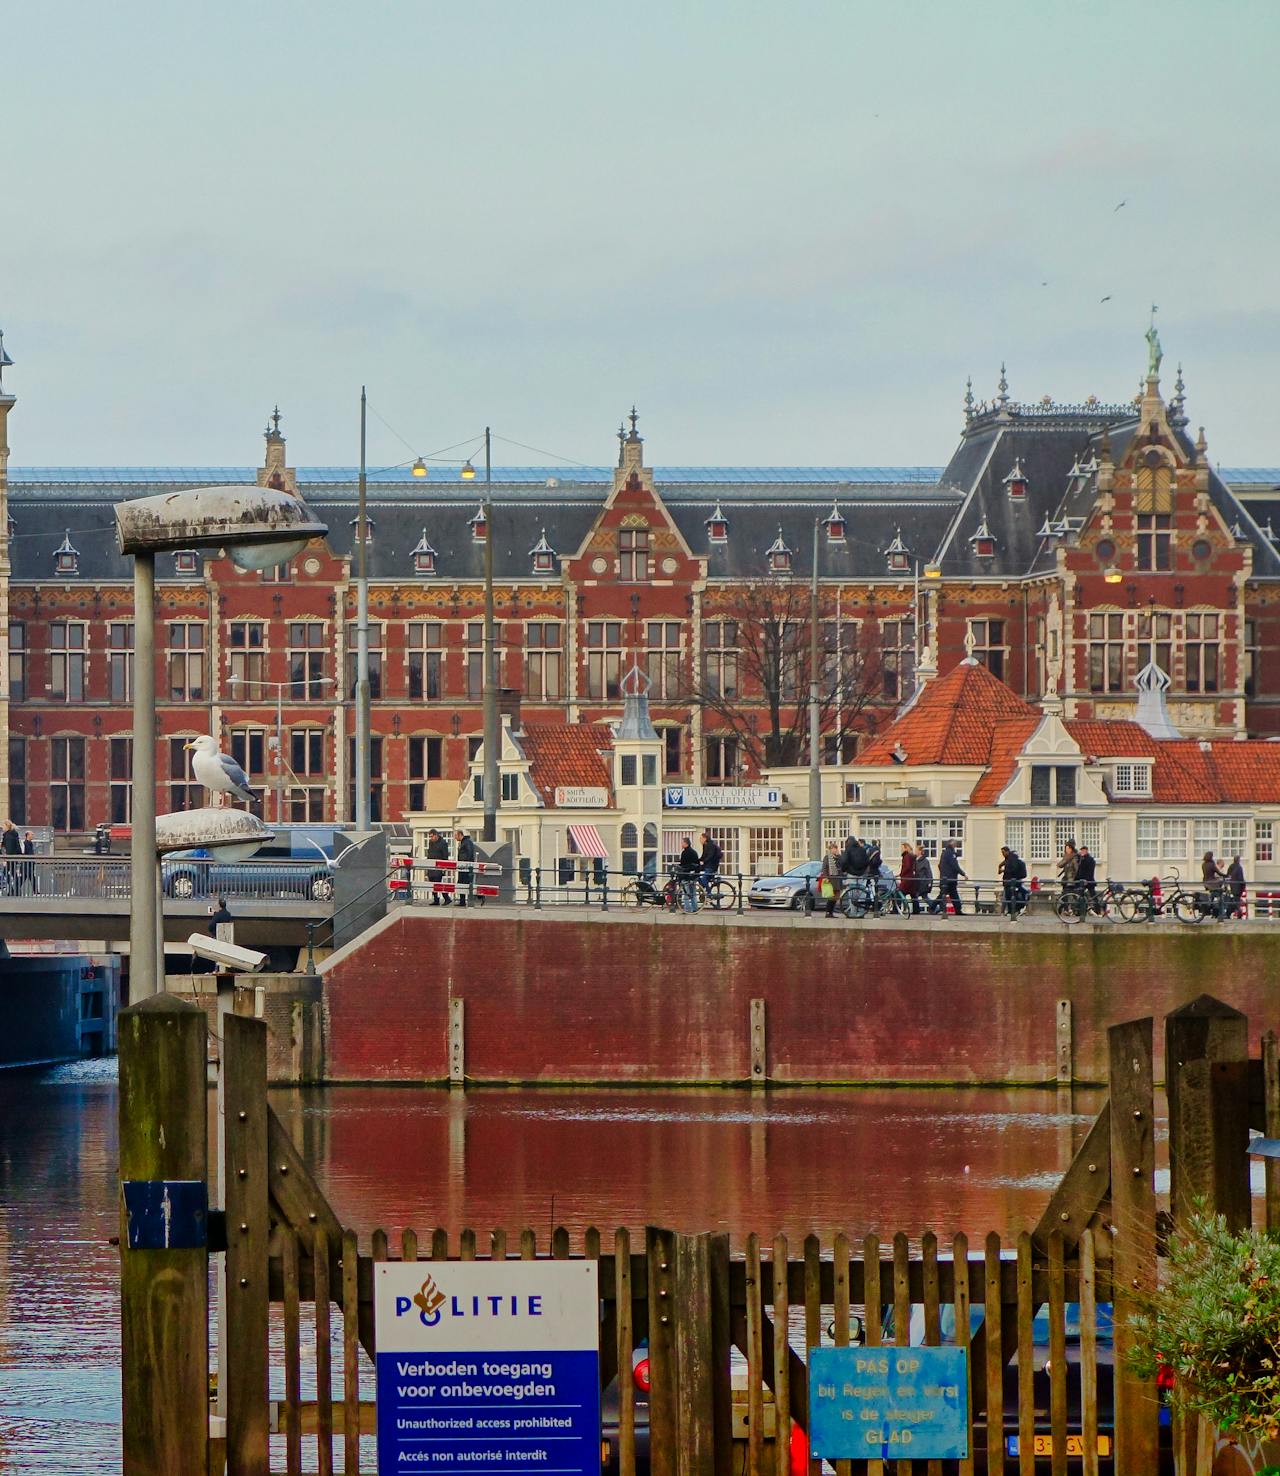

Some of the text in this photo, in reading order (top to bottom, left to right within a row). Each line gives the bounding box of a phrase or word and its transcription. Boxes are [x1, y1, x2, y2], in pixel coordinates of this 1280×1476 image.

[692, 796, 756, 805] AMSTERDAM
[396, 1295, 543, 1327] POLITIE
[396, 1361, 553, 1379] Verboden toegang
[856, 1359, 920, 1374] PAS OP
[397, 1381, 556, 1400] voor onbevoegden
[818, 1384, 836, 1400] bij
[860, 1408, 879, 1421] de
[396, 1417, 572, 1430] Unauthorized access prohibited
[865, 1429, 913, 1445] GLAD
[398, 1449, 548, 1462] Accés non autorisé interdit
